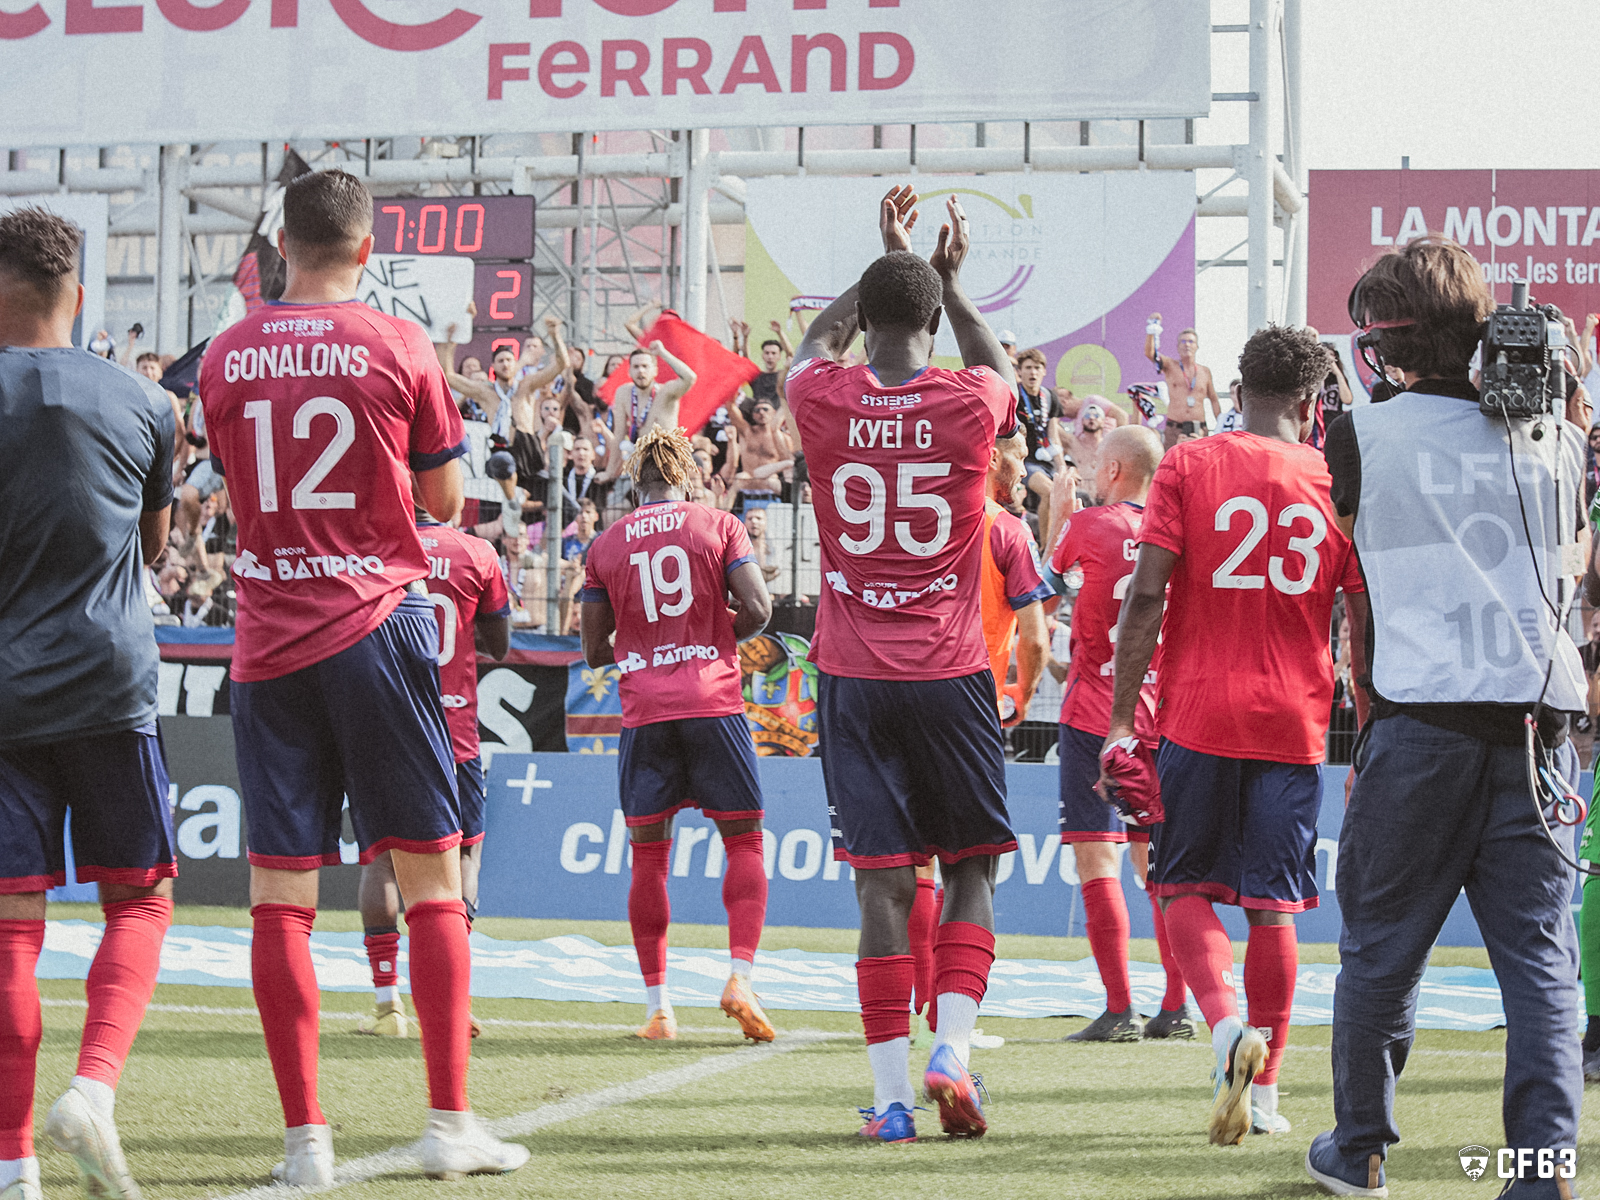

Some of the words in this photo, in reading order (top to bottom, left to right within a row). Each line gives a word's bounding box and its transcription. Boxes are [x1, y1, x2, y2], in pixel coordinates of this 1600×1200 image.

[1371, 206, 1429, 246] LA
[1527, 255, 1558, 284] les
[489, 270, 522, 320] 2
[262, 319, 335, 334] SYSTEMES
[224, 342, 370, 383] GONALONS
[860, 393, 922, 407] SYSTEMES
[915, 419, 932, 449] G
[243, 396, 356, 513] 12
[1417, 452, 1544, 496] LFP
[625, 511, 686, 542] MENDY
[832, 463, 952, 557] 95
[1212, 496, 1327, 595] 23
[275, 554, 385, 581] BATIPRO
[629, 545, 694, 623] 19
[1443, 601, 1523, 669] 10
[652, 645, 720, 667] BATIPRO
